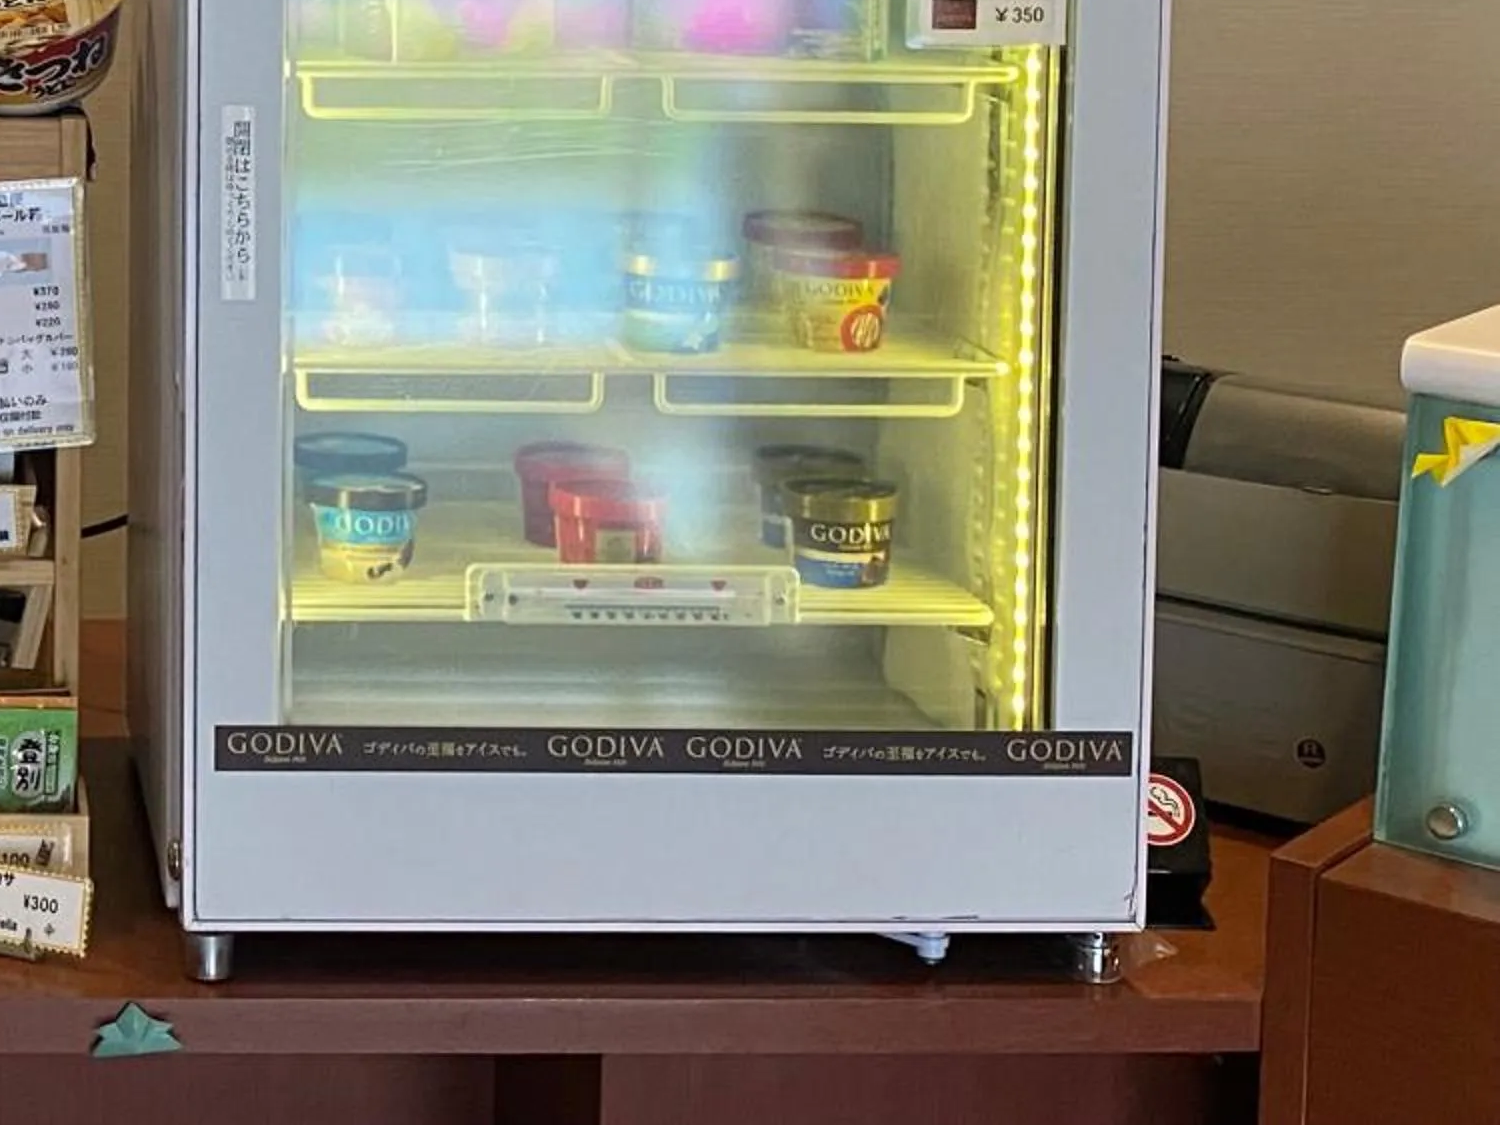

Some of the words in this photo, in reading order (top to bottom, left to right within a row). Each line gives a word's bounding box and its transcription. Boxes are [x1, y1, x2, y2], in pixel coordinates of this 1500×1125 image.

[995, 6, 1044, 24] ¥350
[227, 732, 343, 755] GODIVA
[547, 736, 664, 758] GODIVA
[685, 736, 801, 758] GODIVA
[1006, 738, 1122, 762] GODIVA
[15, 738, 43, 791] 登別
[23, 894, 59, 914] ¥300
